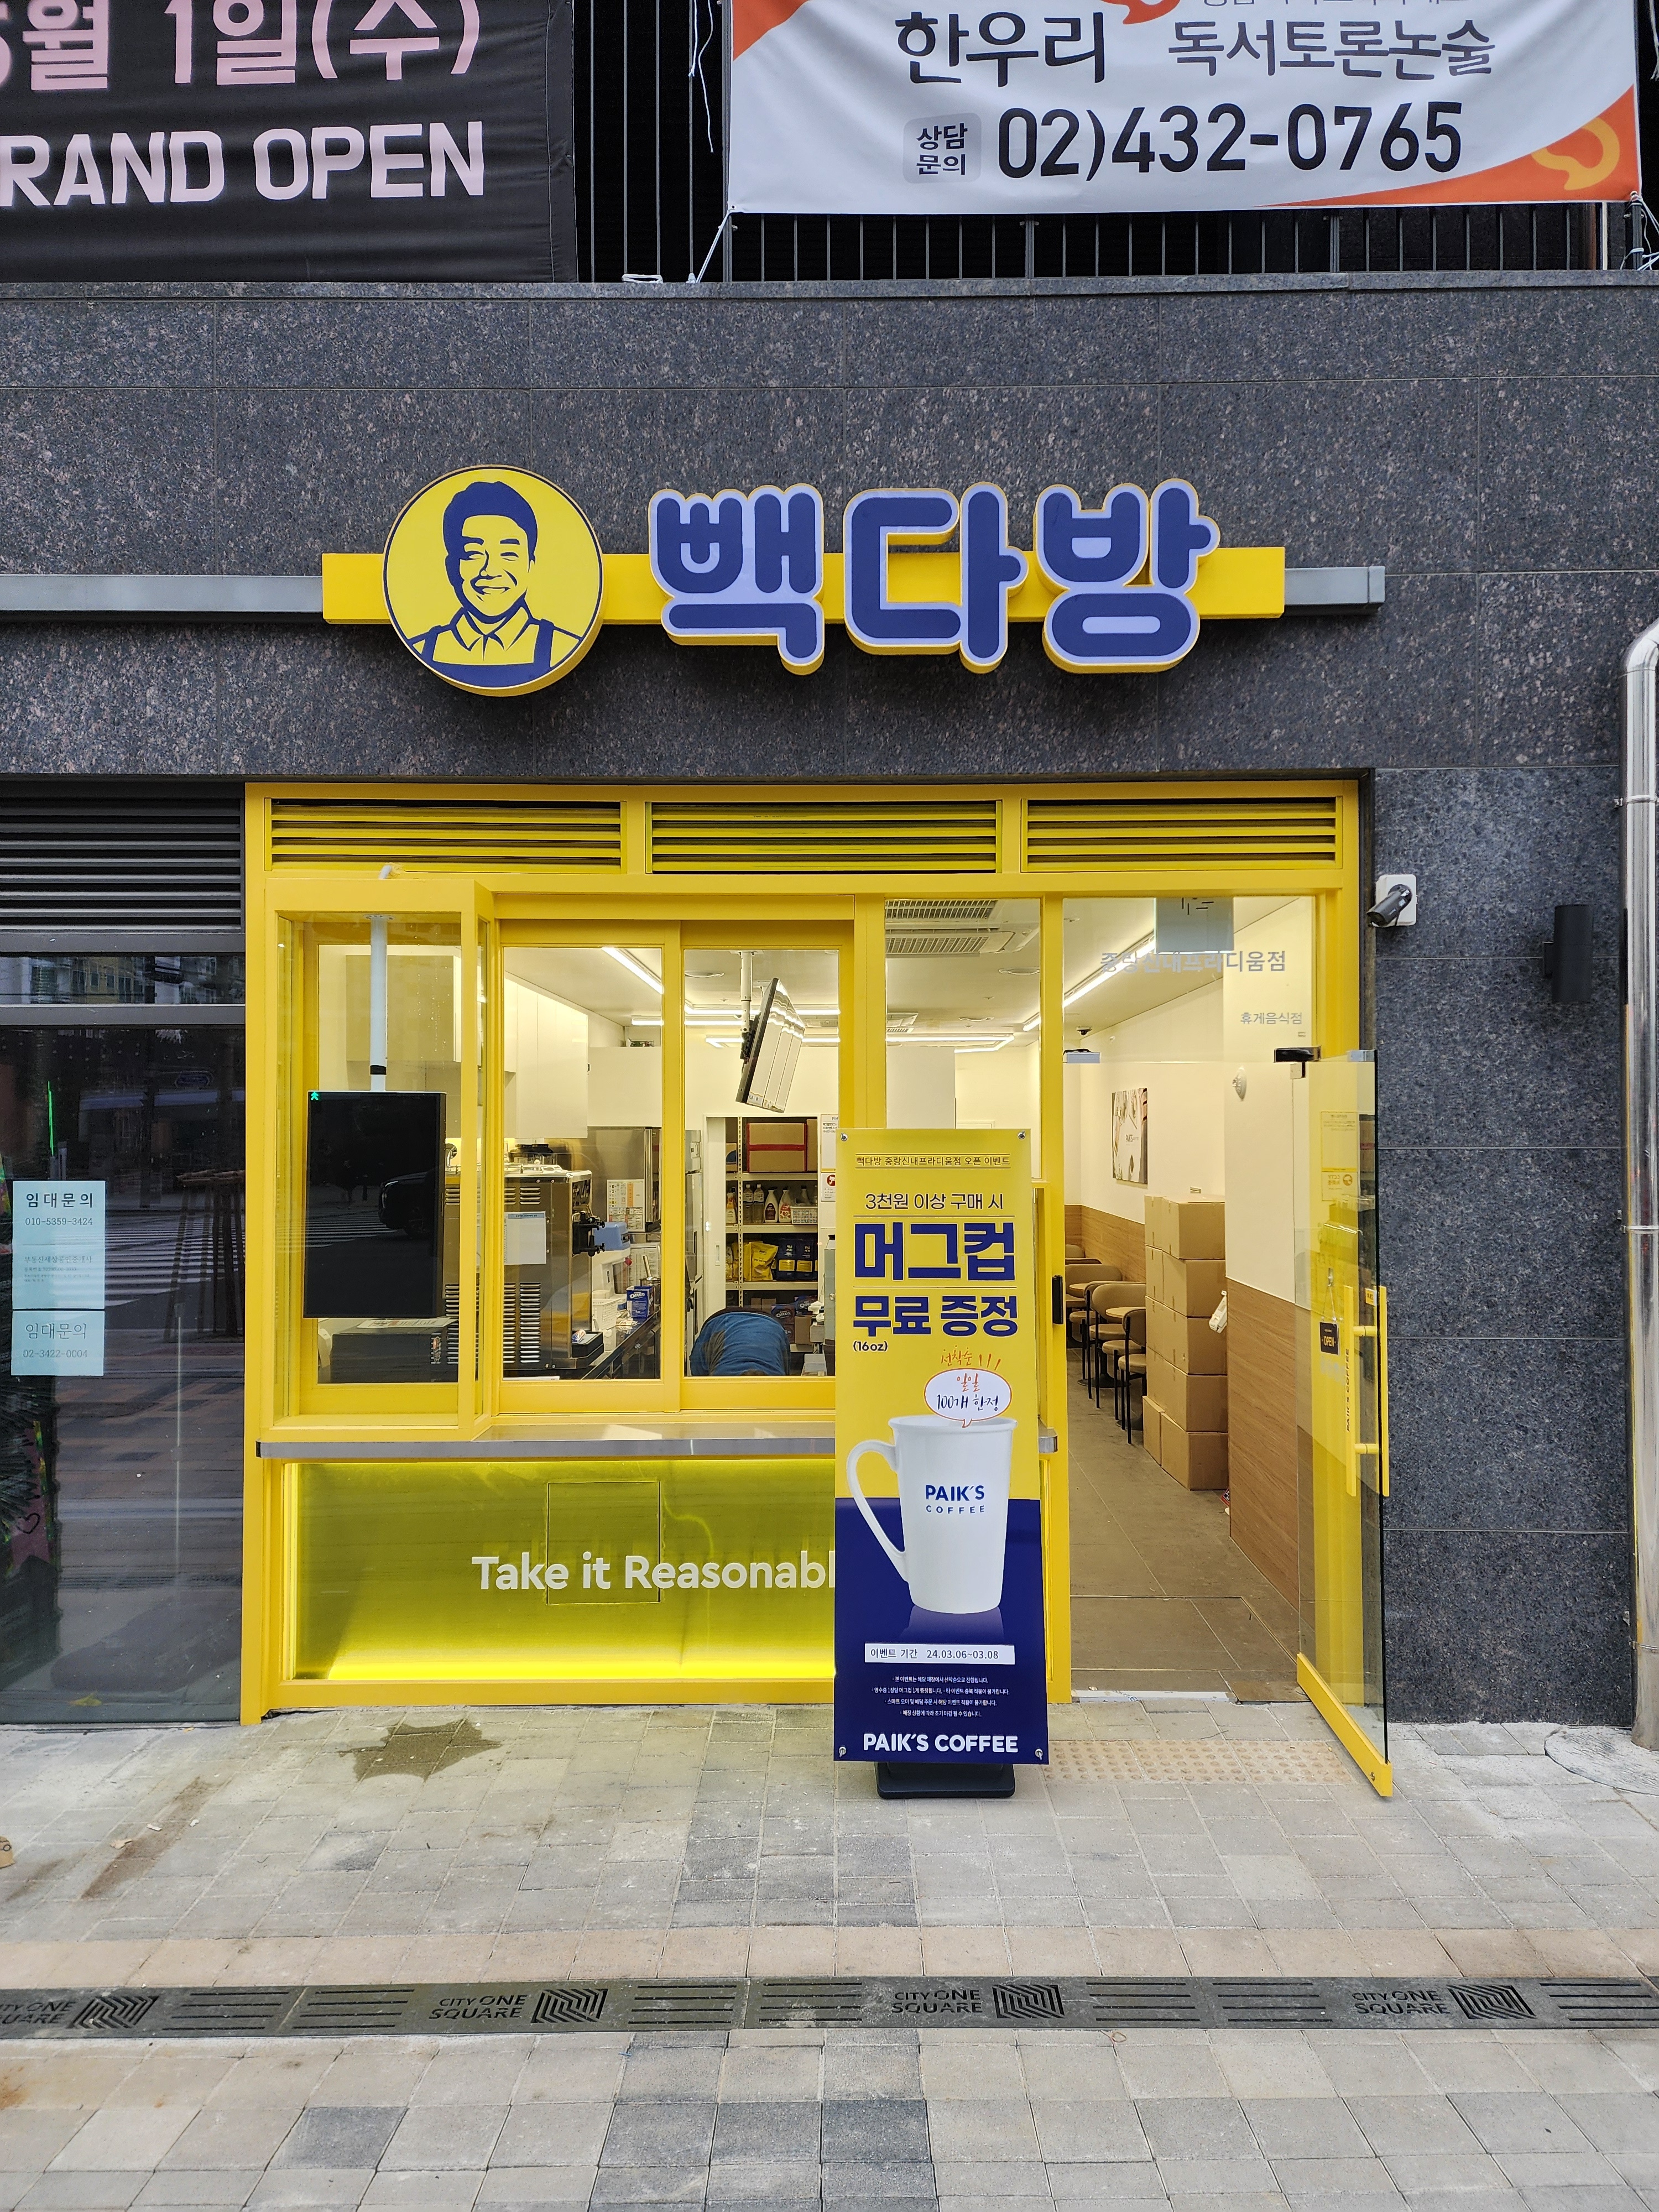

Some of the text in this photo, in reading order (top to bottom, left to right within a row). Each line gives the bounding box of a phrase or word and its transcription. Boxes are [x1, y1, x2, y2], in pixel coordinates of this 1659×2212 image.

[0, 0, 480, 90] 월 1일(수)
[895, 12, 1495, 87] 한우리 독서토론논술
[916, 123, 968, 150] 상담
[999, 101, 1462, 181] 02)432-0765
[255, 121, 484, 200] OPEN
[916, 154, 966, 175] 문의
[649, 480, 1220, 674] 빽다방
[1240, 1012, 1302, 1024] 휴게음식점
[857, 1156, 1010, 1166] 빽다방 중랑신내프라디움점 오픈 이벤트
[26, 1193, 93, 1208] 임대문의
[865, 1193, 1004, 1210] 3천원 이상 구매 시
[854, 1222, 1015, 1281] 머그컵
[853, 1296, 1018, 1337] 무료 증정
[25, 1323, 86, 1339] 임대문의
[853, 1340, 888, 1352] (16oz)
[1323, 1335, 1334, 1347] OPEN
[23, 1349, 88, 1358] 02-3422-0004
[941, 1344, 973, 1366] 선착순
[956, 1373, 980, 1392] 일일
[937, 1394, 999, 1412] 100개 한정
[925, 1484, 985, 1501] PAIK'S
[926, 1505, 985, 1514] COFFEE
[471, 1552, 569, 1590] Take
[582, 1551, 611, 1589] it
[870, 1648, 999, 1659] 이벤트 기간 24.03.06~03.08
[863, 1733, 1018, 1752] PAIK'S COFFEE
[439, 1995, 528, 2006] CITY ONE
[894, 1990, 981, 2001] CITY ONE
[1352, 1990, 1442, 2001] CITY ONE
[26, 2002, 76, 2012] ONE
[429, 2007, 523, 2020] SQUARE
[891, 2002, 983, 2014] SQUARE
[1355, 2003, 1451, 2015] SQUARE
